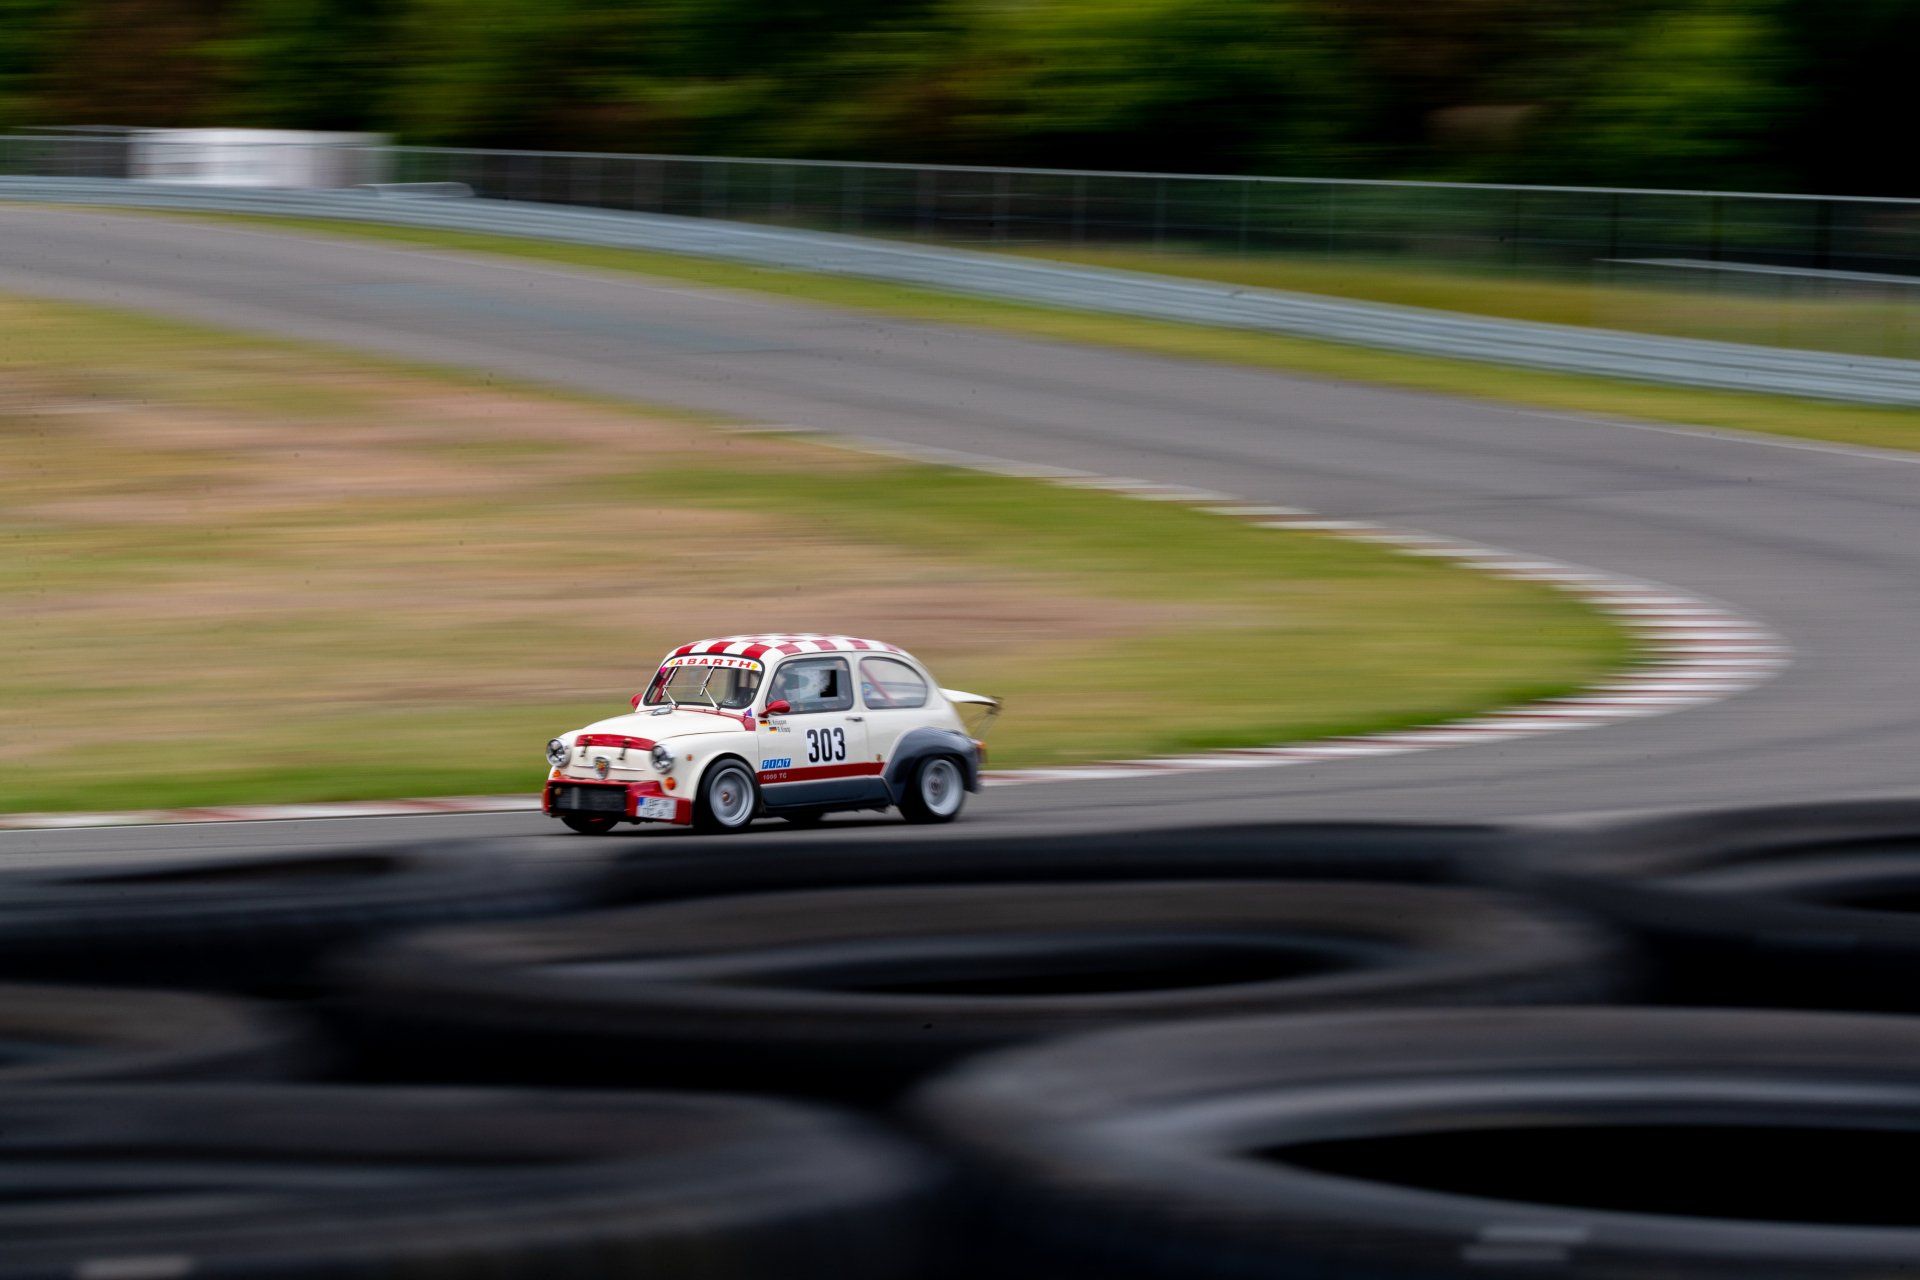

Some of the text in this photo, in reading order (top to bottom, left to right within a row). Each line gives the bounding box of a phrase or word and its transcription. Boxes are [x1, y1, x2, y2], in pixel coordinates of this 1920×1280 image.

[674, 658, 751, 669] ABARTH
[806, 727, 846, 763] 303
[763, 759, 790, 769] FIAT
